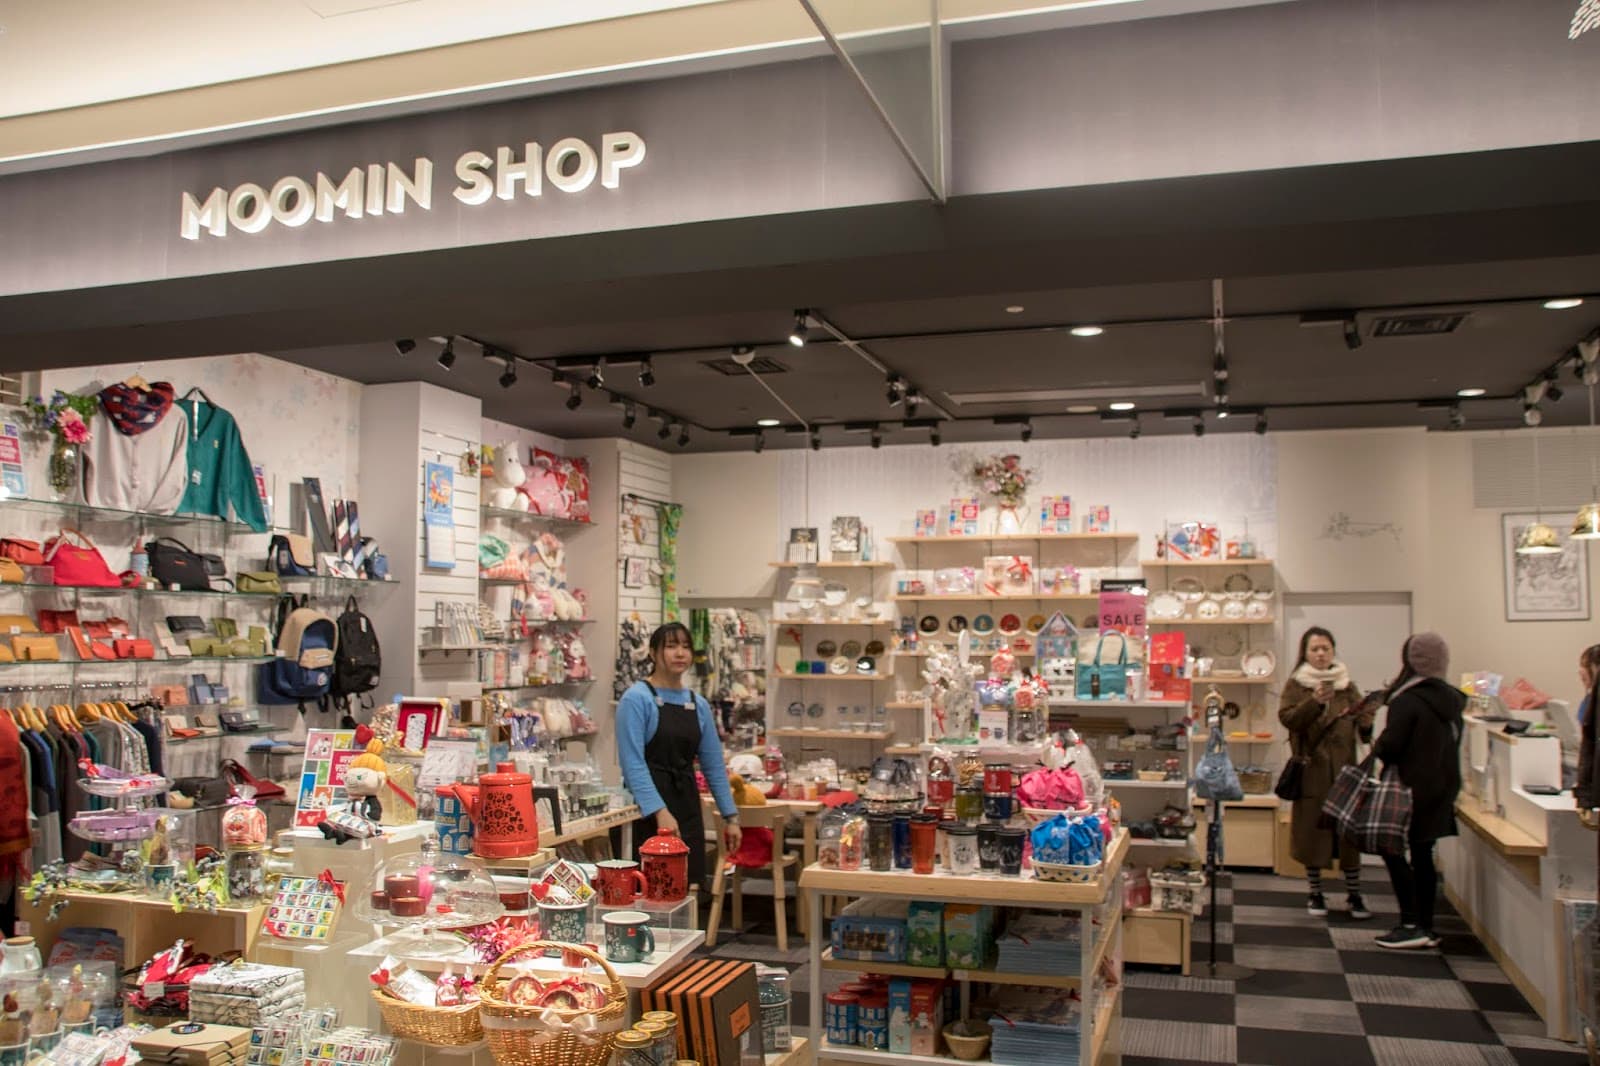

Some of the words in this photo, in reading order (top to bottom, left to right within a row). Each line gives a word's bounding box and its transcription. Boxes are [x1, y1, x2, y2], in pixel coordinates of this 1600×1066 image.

[180, 156, 433, 241] MOOMIN
[452, 131, 647, 206] SHOP
[1102, 613, 1143, 627] SALE
